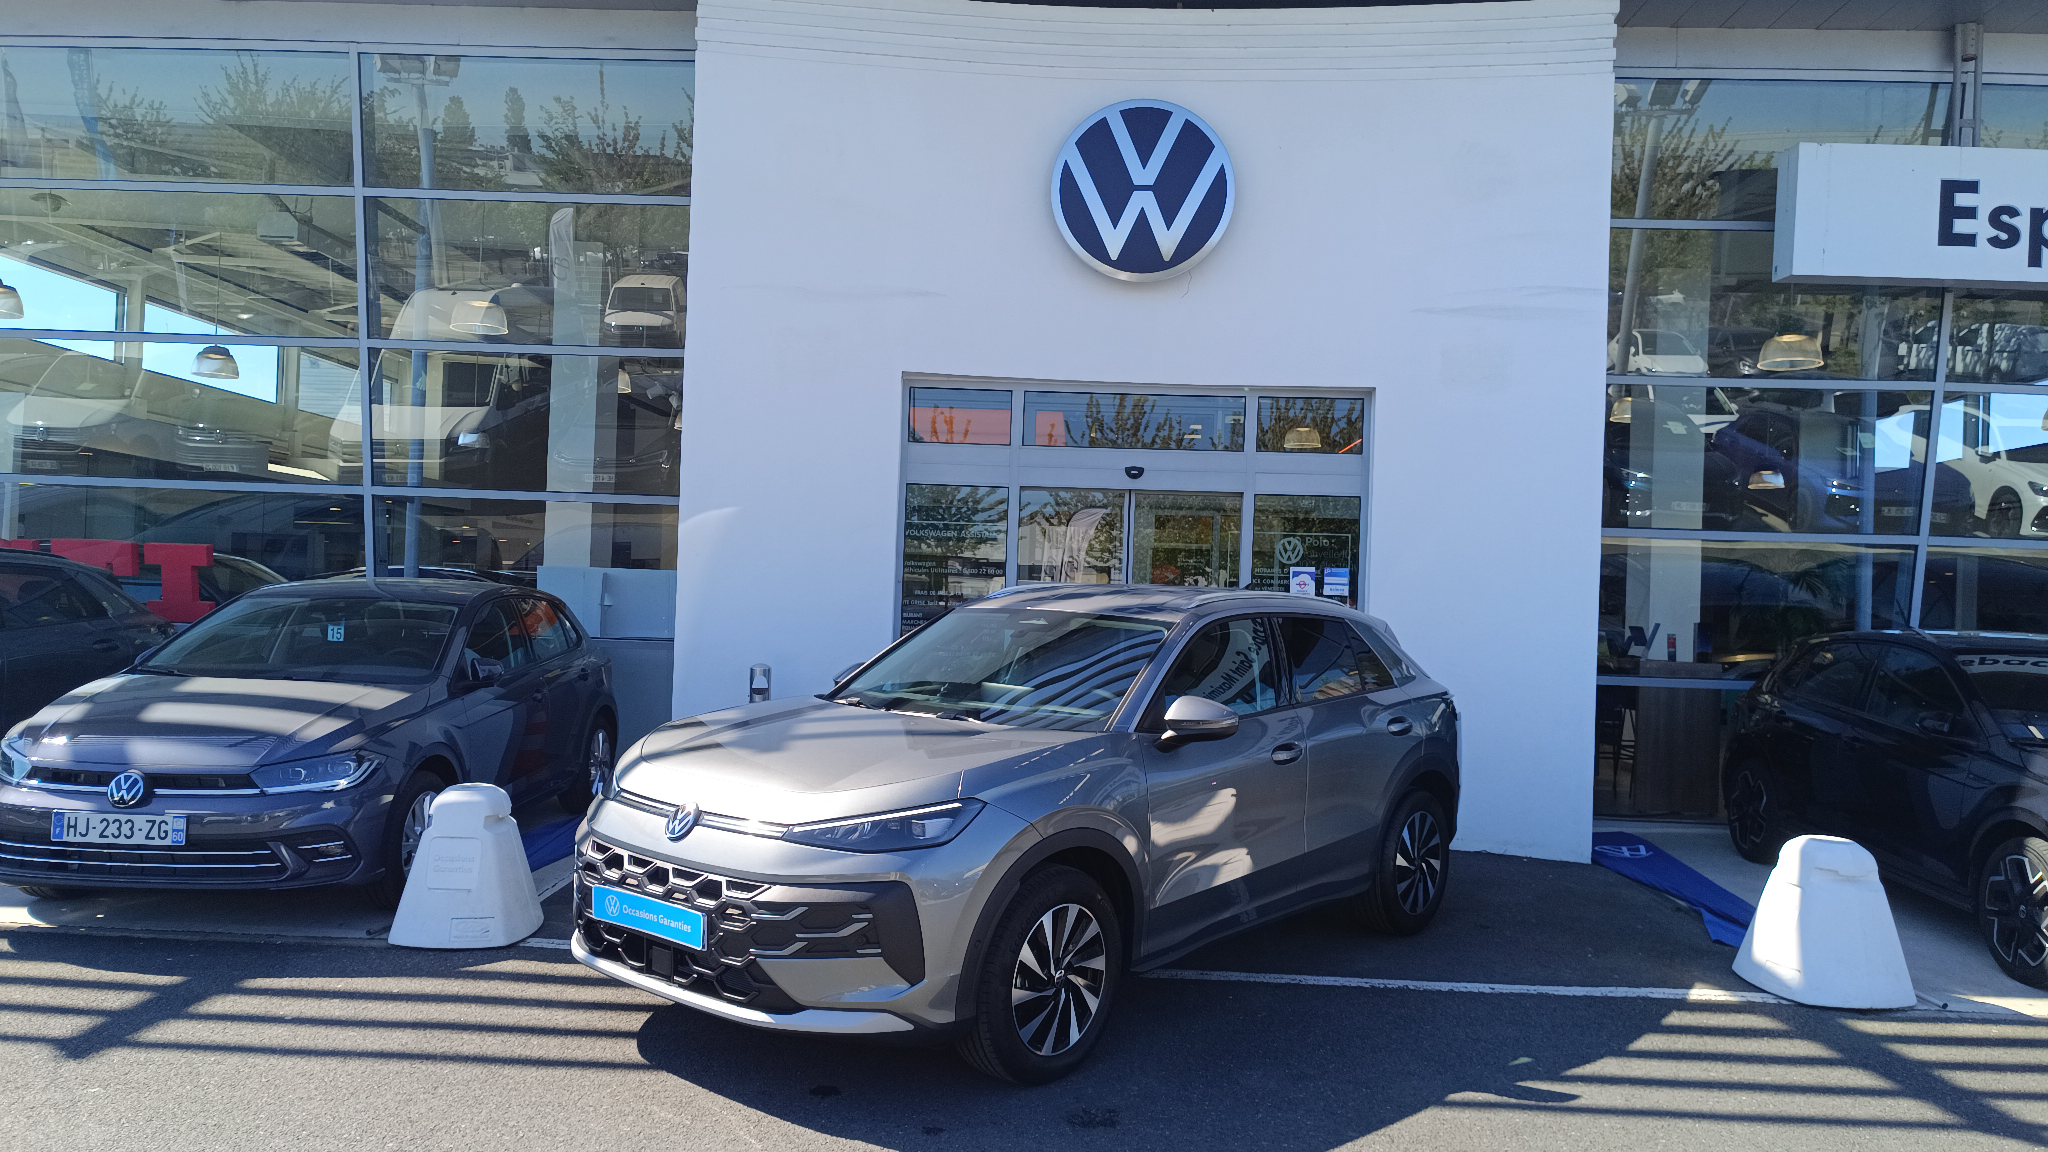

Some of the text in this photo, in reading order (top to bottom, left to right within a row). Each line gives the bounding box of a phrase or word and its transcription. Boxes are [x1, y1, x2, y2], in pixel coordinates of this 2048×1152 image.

[1937, 178, 2048, 268] Esp
[330, 626, 343, 640] 15
[66, 816, 169, 841] HJ-233-ZG
[172, 831, 184, 842] 60
[622, 904, 658, 922] Occasions
[658, 914, 692, 933] Garanties
